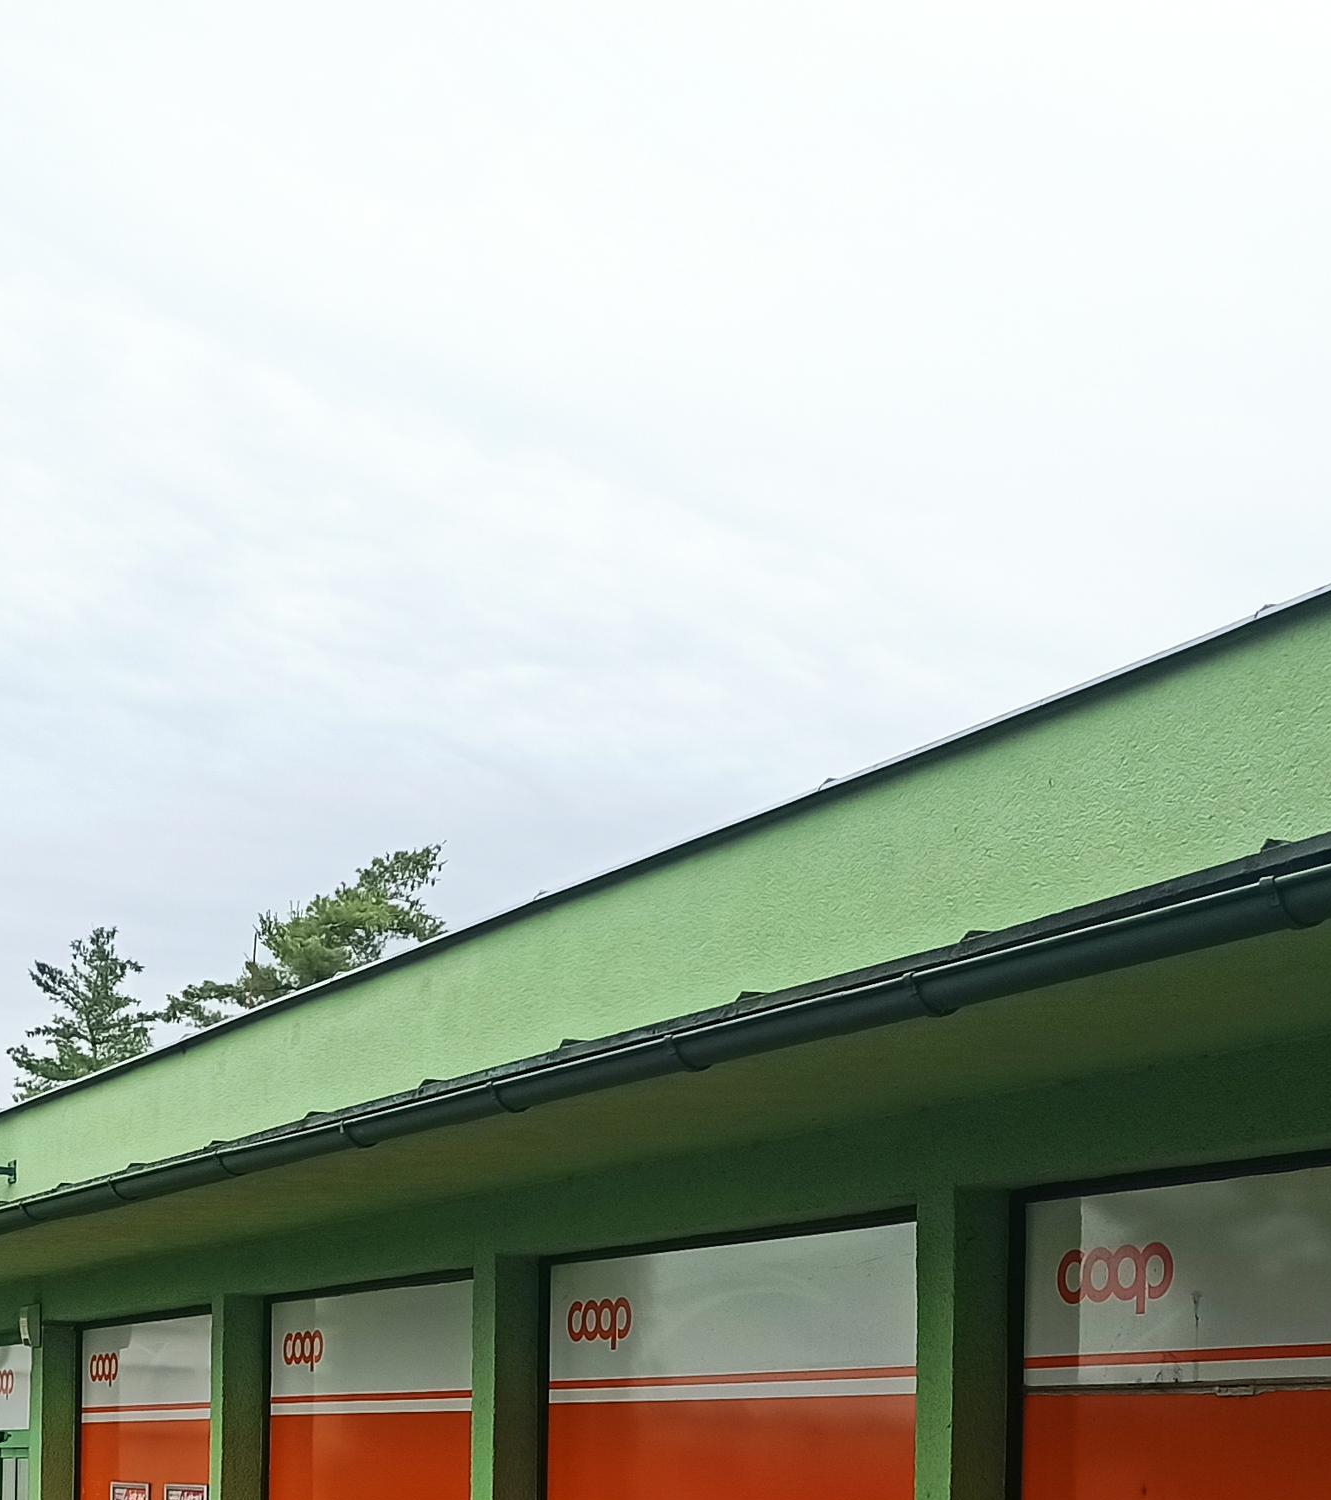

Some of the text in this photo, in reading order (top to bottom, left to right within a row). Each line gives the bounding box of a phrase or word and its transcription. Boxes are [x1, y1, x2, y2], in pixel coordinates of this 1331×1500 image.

[1057, 1241, 1174, 1315] coop
[567, 1296, 632, 1350] coop
[90, 1352, 118, 1387] coop
[283, 1329, 324, 1372] coop
